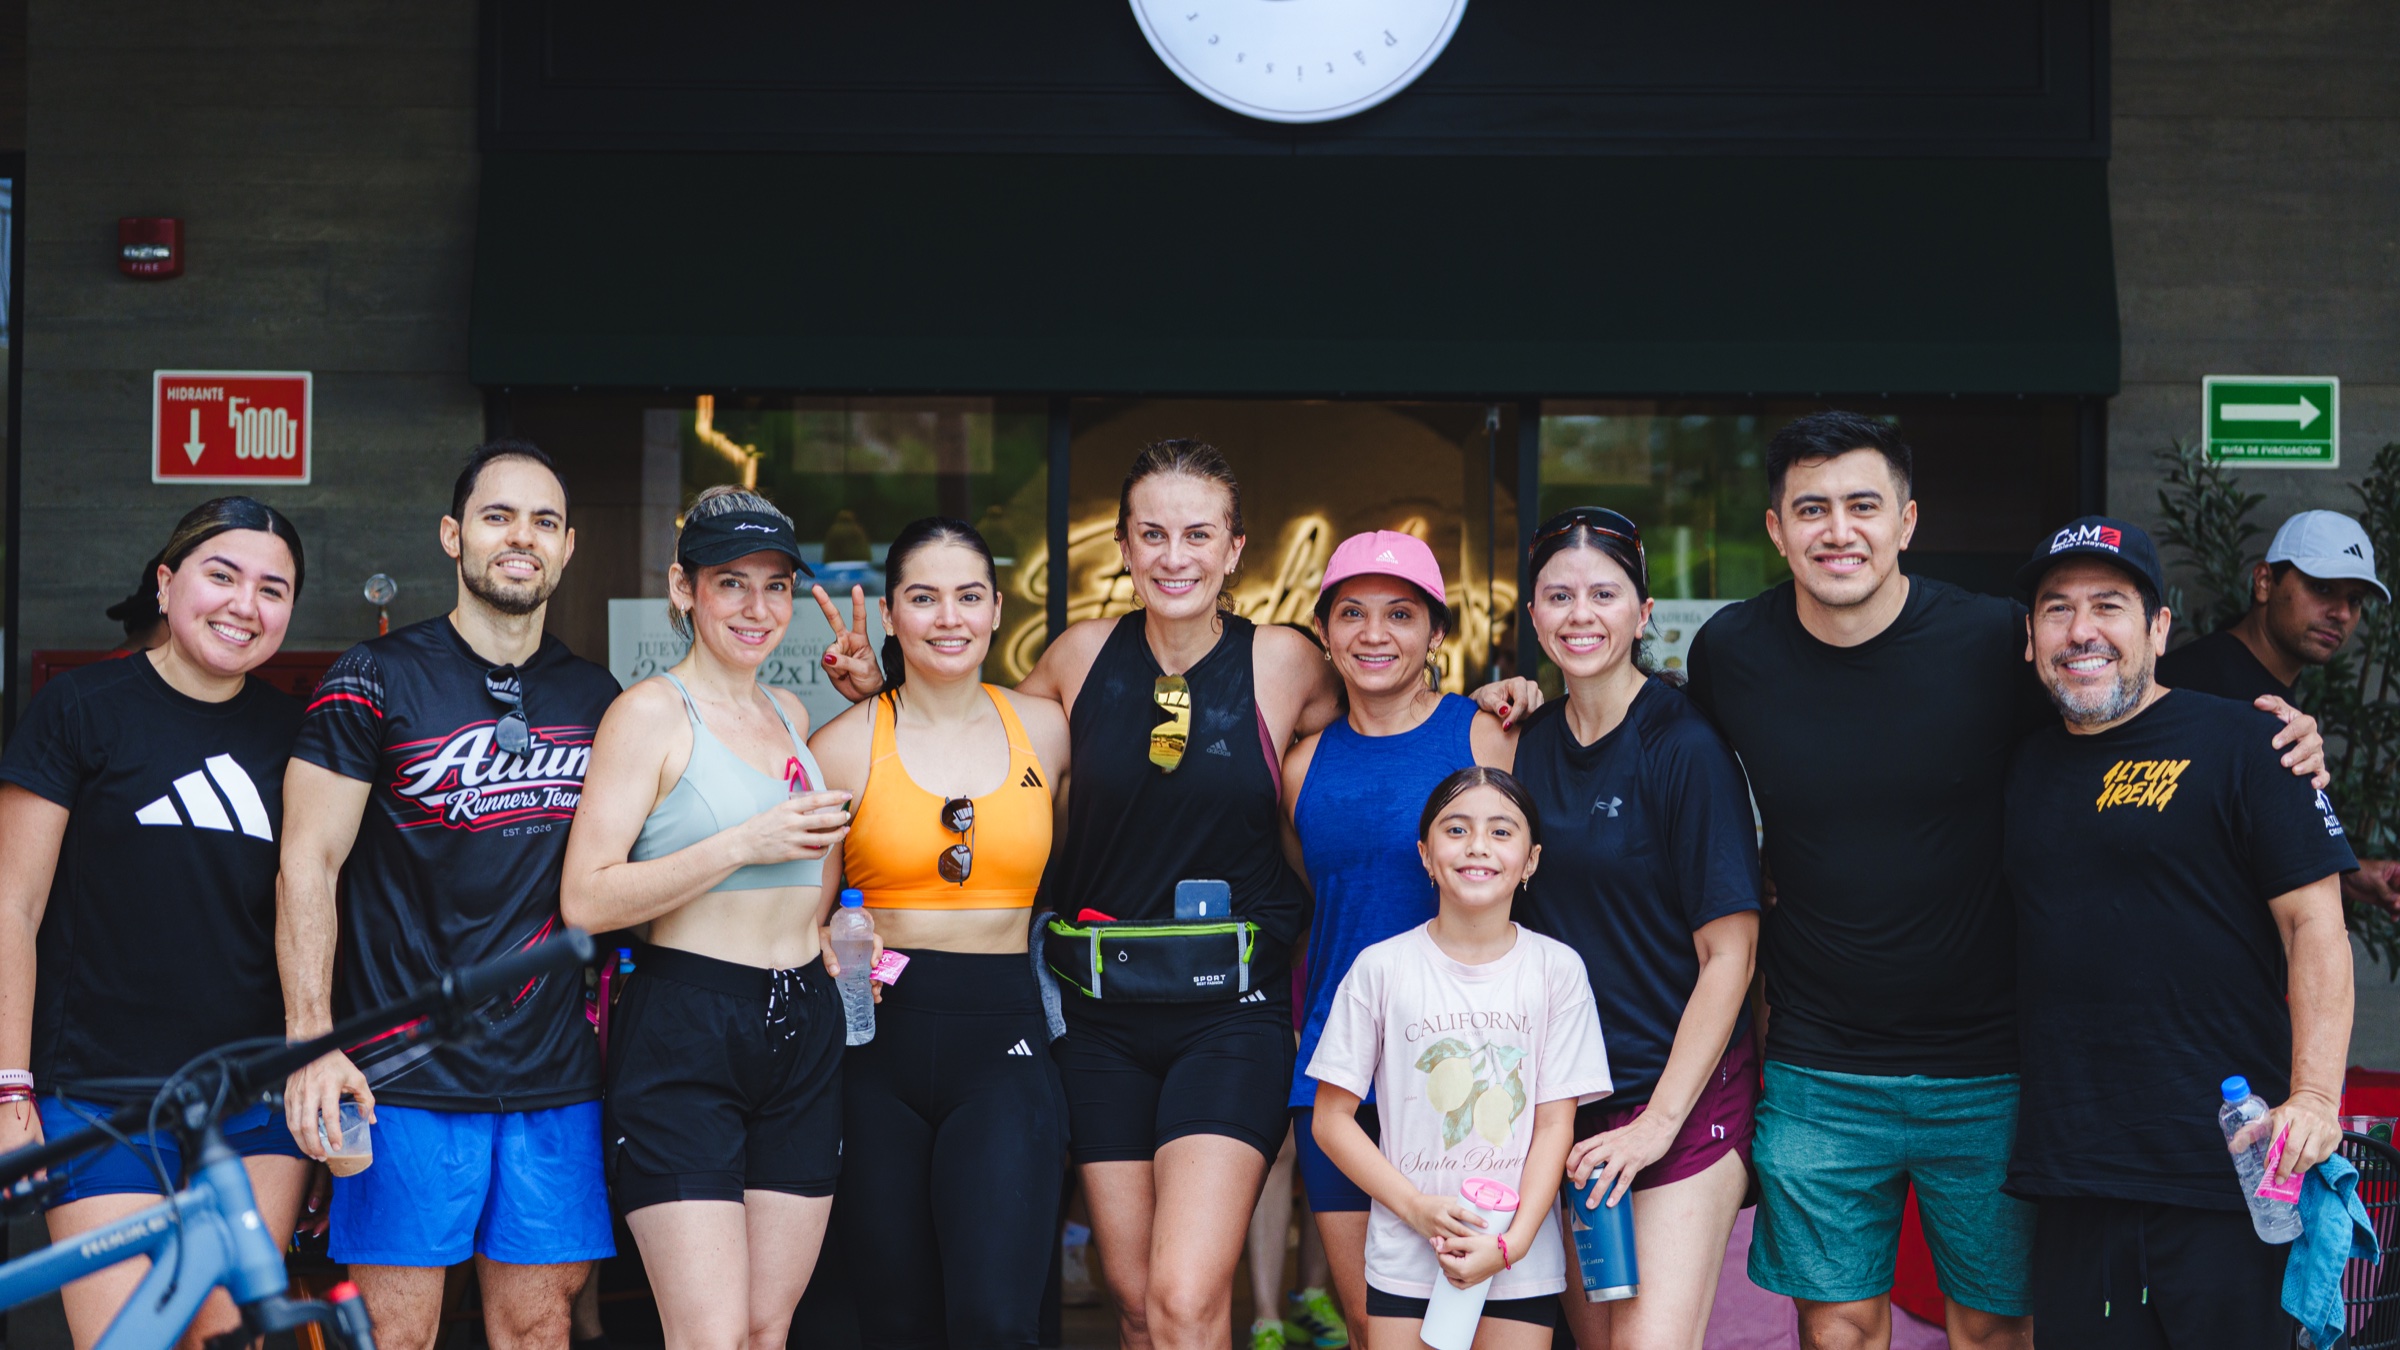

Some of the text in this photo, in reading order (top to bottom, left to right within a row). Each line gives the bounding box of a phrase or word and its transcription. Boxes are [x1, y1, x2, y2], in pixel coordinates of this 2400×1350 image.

[132, 263, 159, 271] FIRE
[167, 387, 224, 402] HIDRANTE
[1206, 747, 1231, 757] adidas
[2103, 759, 2190, 788] ALTUM
[445, 787, 540, 821] Runners
[2096, 783, 2178, 812] ARENA
[1193, 974, 1226, 983] SPORT
[1400, 1147, 1459, 1175] Santa
